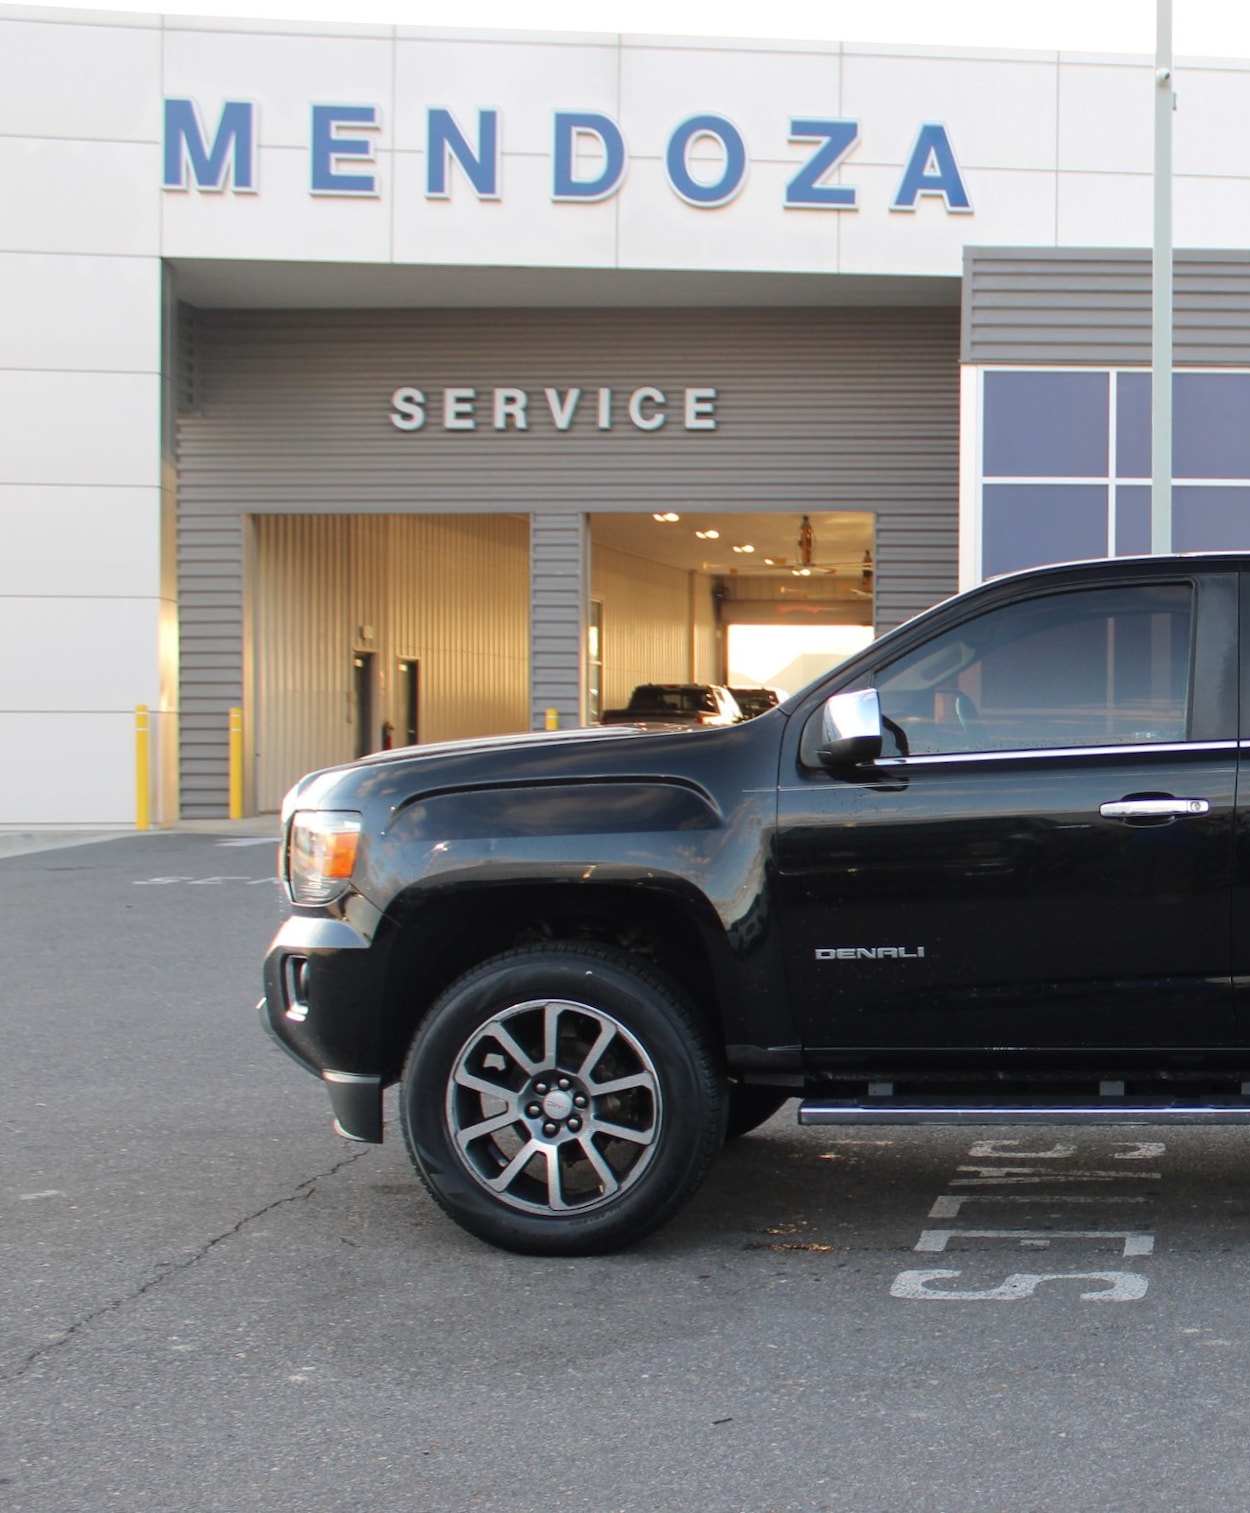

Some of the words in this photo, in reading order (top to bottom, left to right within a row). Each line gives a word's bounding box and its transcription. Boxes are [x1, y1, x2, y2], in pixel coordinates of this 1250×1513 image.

[161, 95, 975, 213] MENDOZA
[391, 386, 720, 432] SERVICE
[815, 946, 925, 960] DENALI
